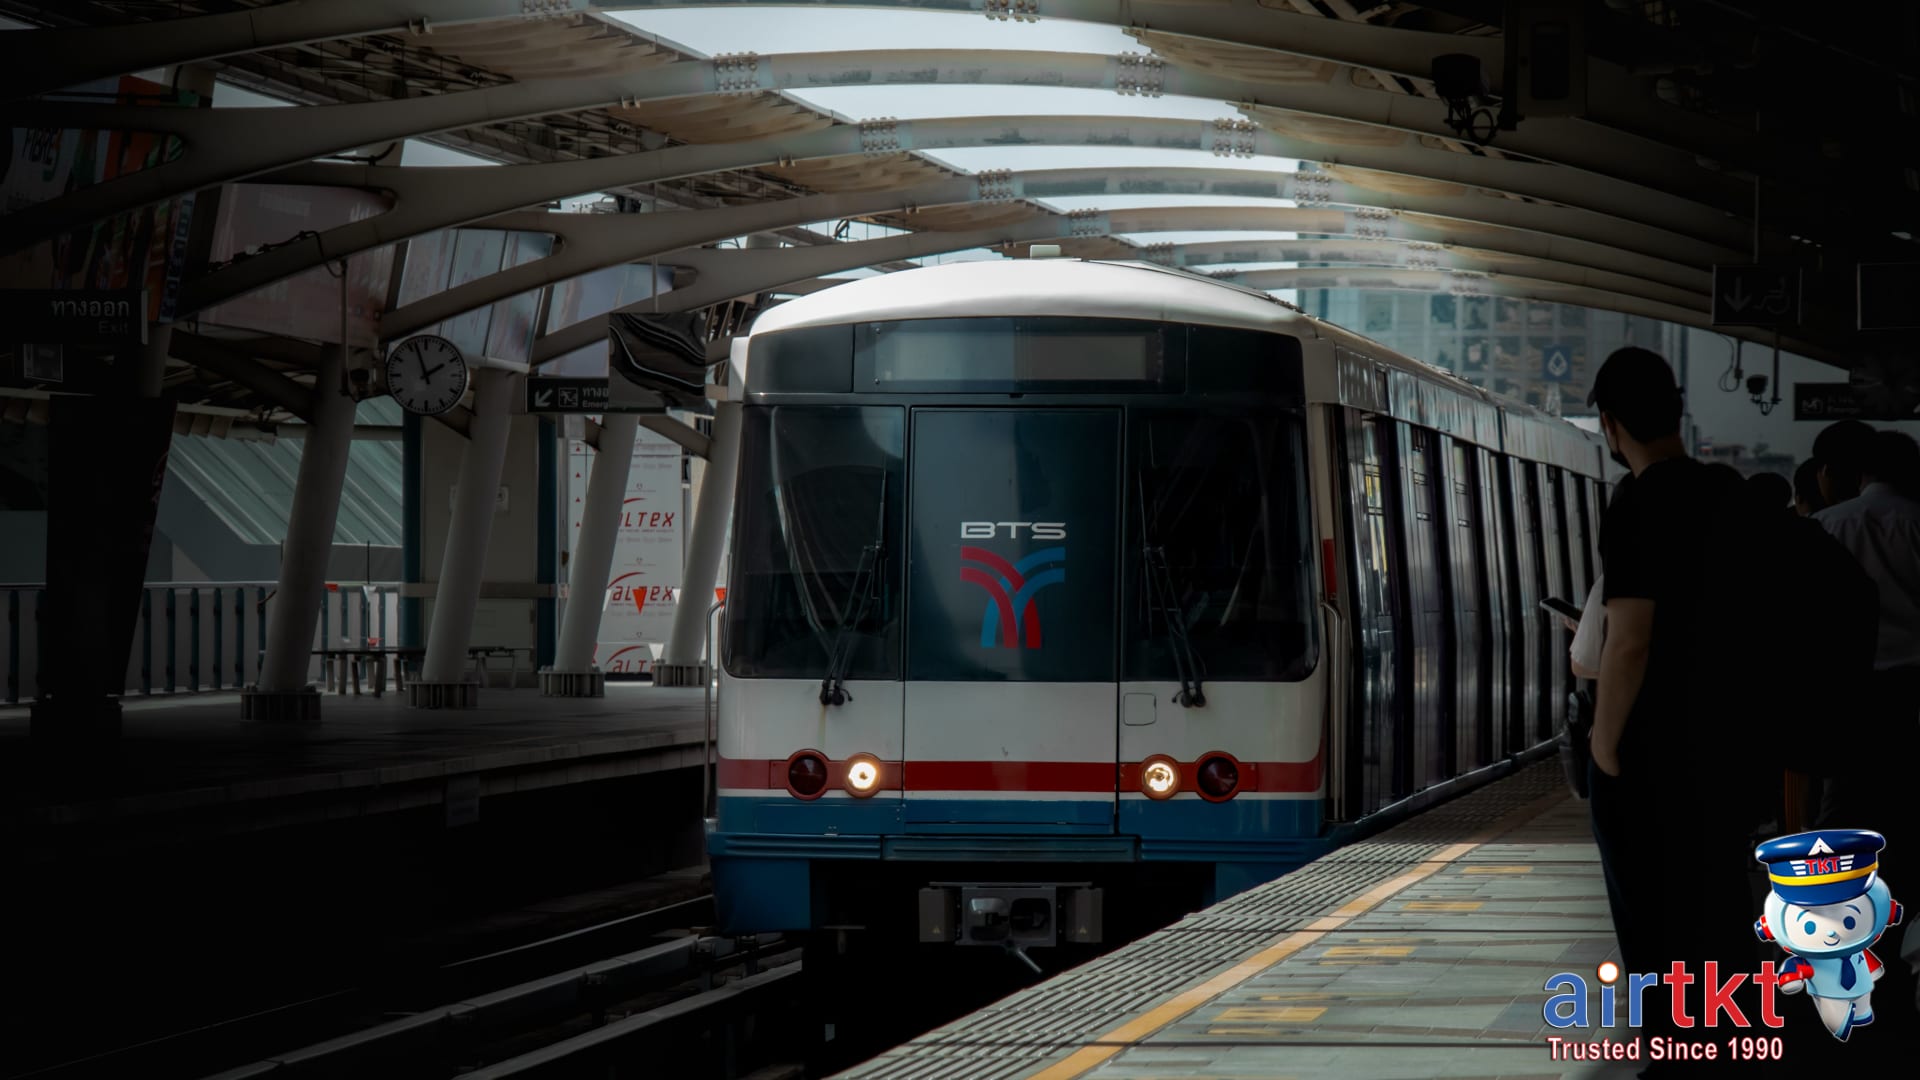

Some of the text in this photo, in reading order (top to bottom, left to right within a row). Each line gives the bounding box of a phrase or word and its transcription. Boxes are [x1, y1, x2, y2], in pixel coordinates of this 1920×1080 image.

[52, 300, 130, 317] ทางออก
[97, 320, 129, 335] Exit
[960, 521, 1067, 540] BTS
